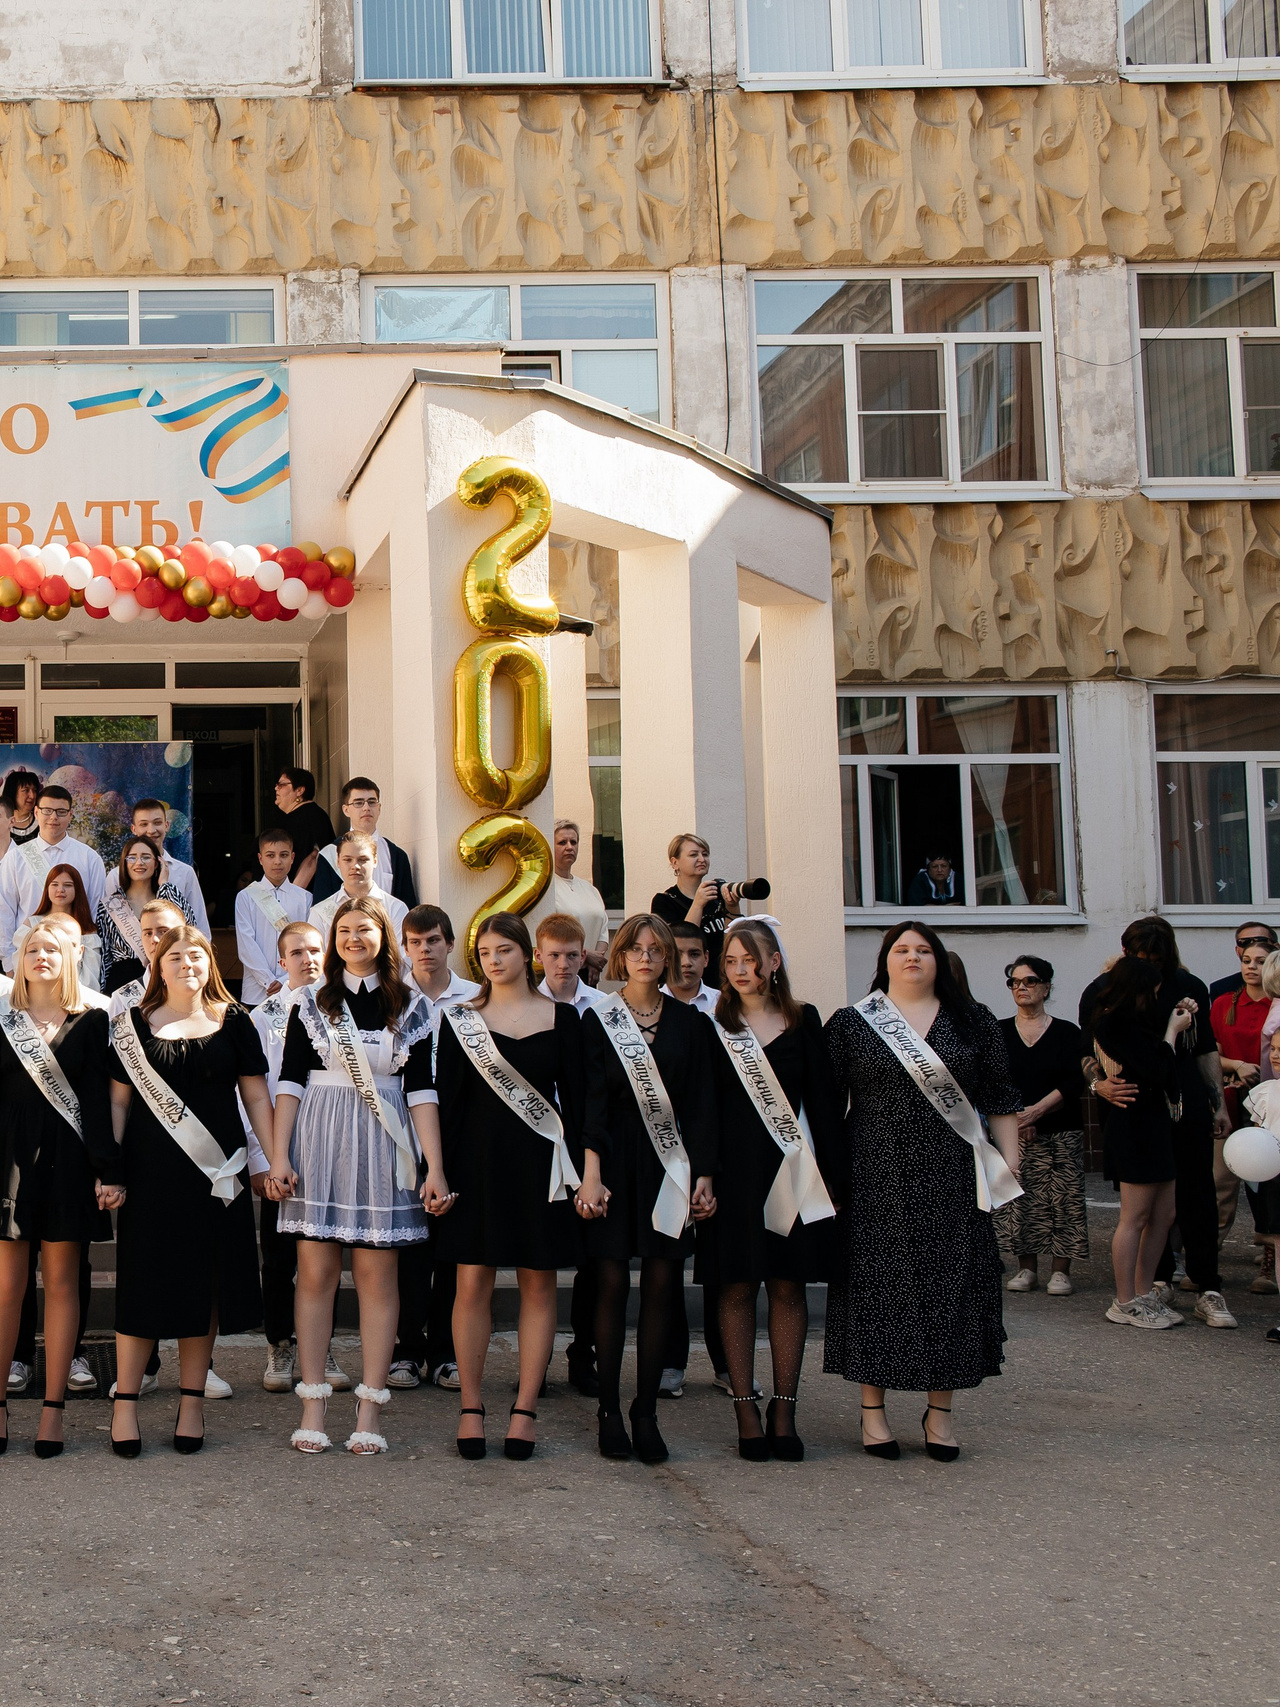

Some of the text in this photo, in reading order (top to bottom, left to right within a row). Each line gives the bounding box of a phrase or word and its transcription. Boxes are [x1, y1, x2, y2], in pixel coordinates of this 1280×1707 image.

[186, 730, 217, 741] ВХОД
[11, 1028, 72, 1108] Выпускница
[112, 1025, 164, 1106] Выпускница
[457, 1022, 551, 1121] Выпускник 2025
[614, 1031, 679, 1150] Выпускник 2025
[722, 1029, 802, 1143] Выпускник 2025
[871, 1011, 964, 1109] Выпускник 2025
